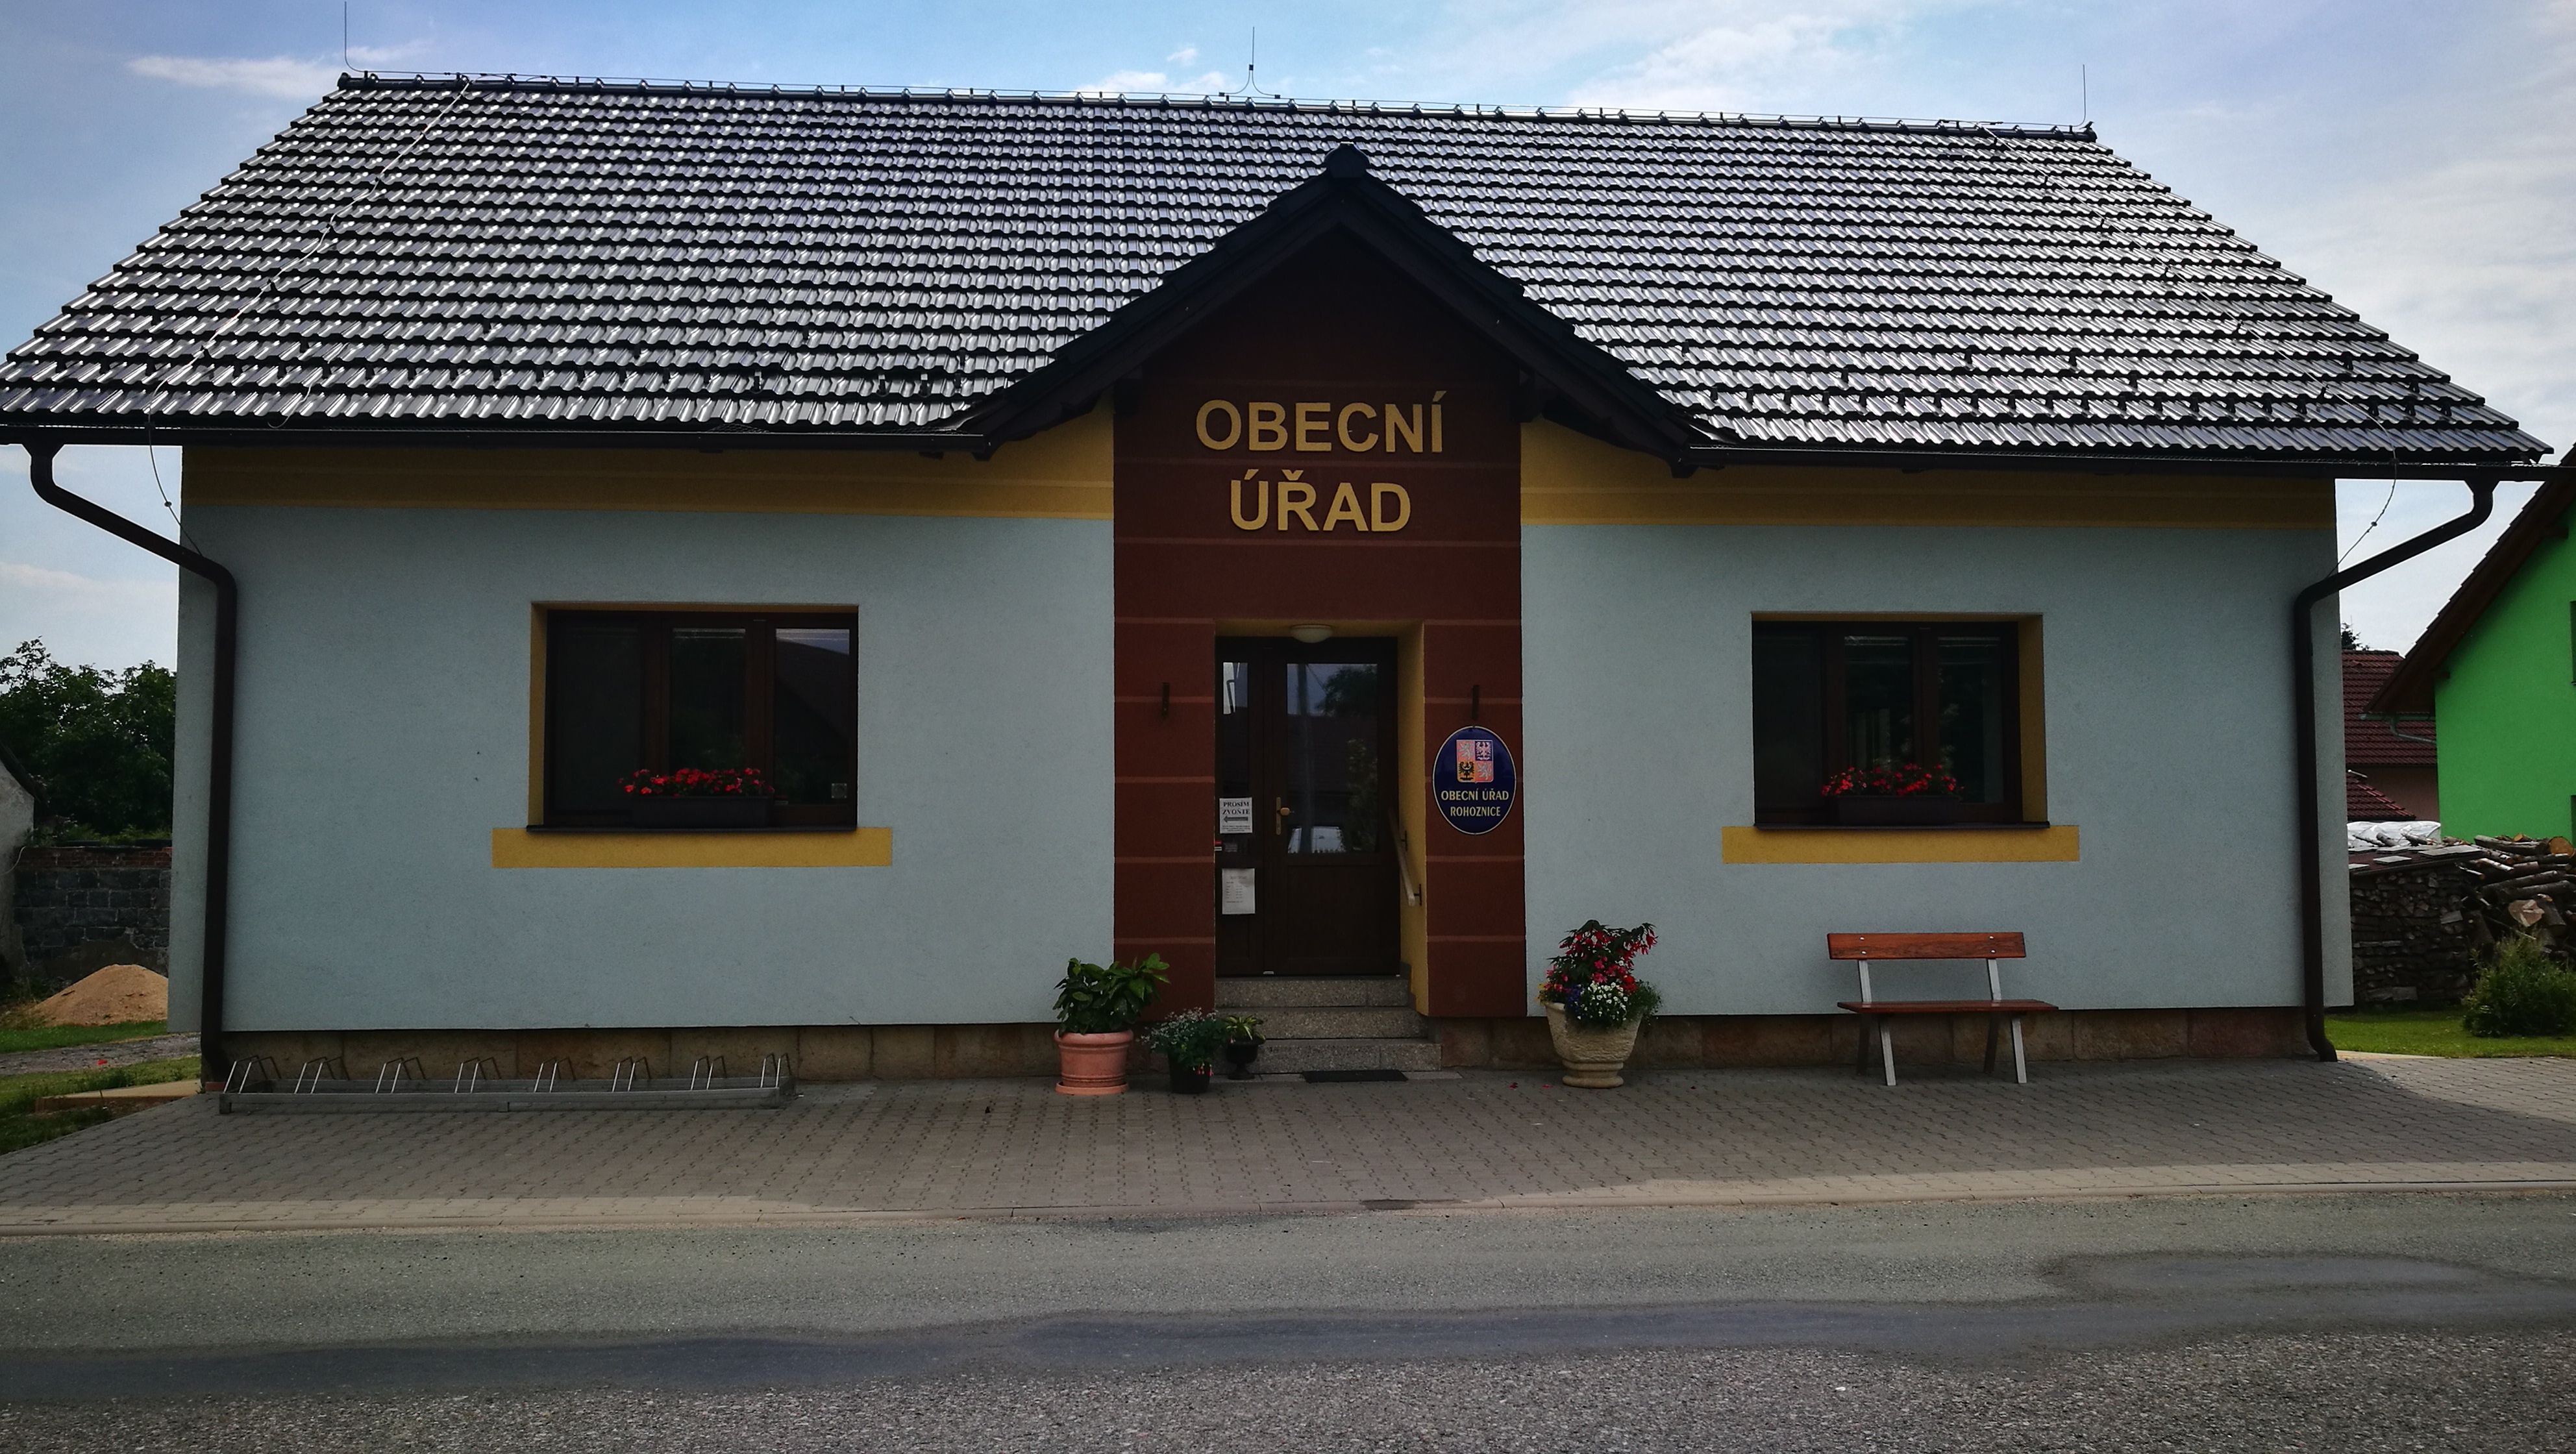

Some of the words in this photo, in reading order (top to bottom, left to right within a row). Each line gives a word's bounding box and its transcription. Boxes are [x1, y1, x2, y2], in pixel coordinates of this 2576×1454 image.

[1196, 391, 1446, 452] OBECNÍ
[1230, 469, 1411, 532] ÚŘAD
[1441, 788, 1479, 801] OBECNÍ
[1482, 788, 1509, 800] ÚŘAD
[1450, 806, 1501, 817] ROHOZNICE
